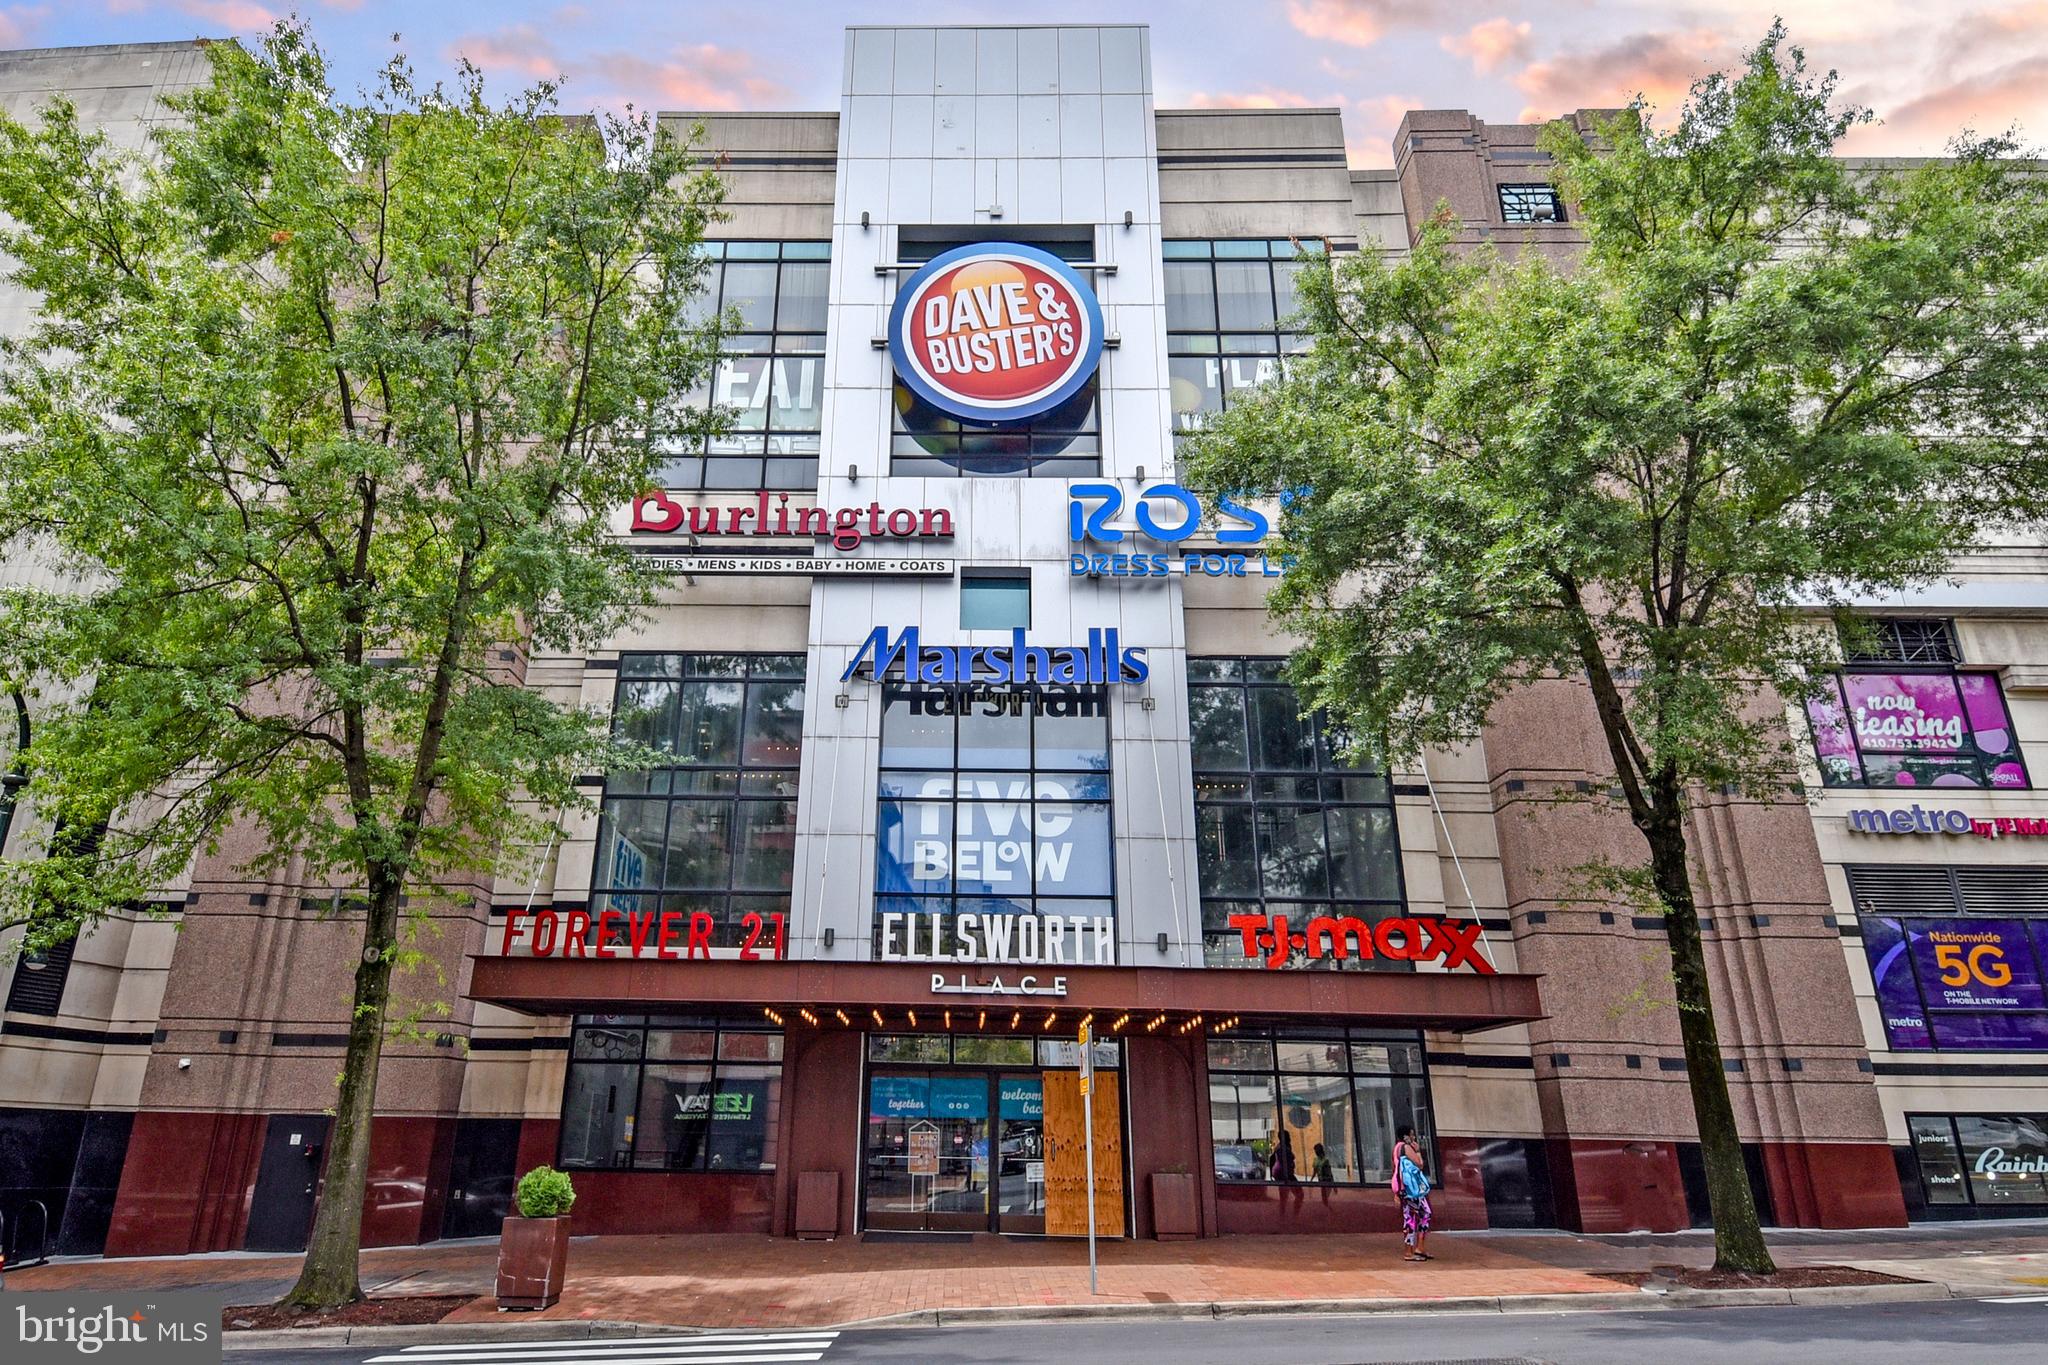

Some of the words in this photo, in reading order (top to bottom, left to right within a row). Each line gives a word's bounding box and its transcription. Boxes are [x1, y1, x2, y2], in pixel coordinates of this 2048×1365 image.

[924, 282, 1035, 338] DAVE
[1033, 282, 1071, 321] &
[926, 322, 1075, 374] BUSTER'S
[630, 490, 955, 551] Burlington
[1069, 484, 1314, 543] ROS
[697, 559, 737, 570] MENS
[749, 560, 782, 571] KIDS
[795, 560, 832, 571] BABY
[845, 561, 887, 571] HOME
[899, 561, 946, 572] COATS
[1070, 554, 1170, 577] DRESS
[1184, 554, 1248, 578] FOR
[840, 626, 1149, 684] Marshalls
[1866, 695, 1916, 711] now
[1856, 706, 1964, 748] leasing
[1862, 738, 1948, 750] 410.753.3942
[915, 777, 1073, 837] five
[1848, 803, 1970, 833] metro
[502, 909, 715, 960] FOREVER
[739, 911, 785, 961] 21
[881, 912, 1116, 966] ELLSWORTH
[1929, 931, 2001, 943] Nationwide
[1935, 944, 2013, 988] 5G
[931, 973, 1067, 996] PLACE
[1943, 990, 1956, 998] ON
[1956, 990, 1972, 998] THE
[1981, 997, 2020, 1006] NETWORK
[1888, 1017, 1923, 1029] metro
[888, 1098, 926, 1111] together
[1022, 1101, 1043, 1114] bac
[1918, 1134, 1949, 1144] juniors
[1930, 1175, 1956, 1184] shoes
